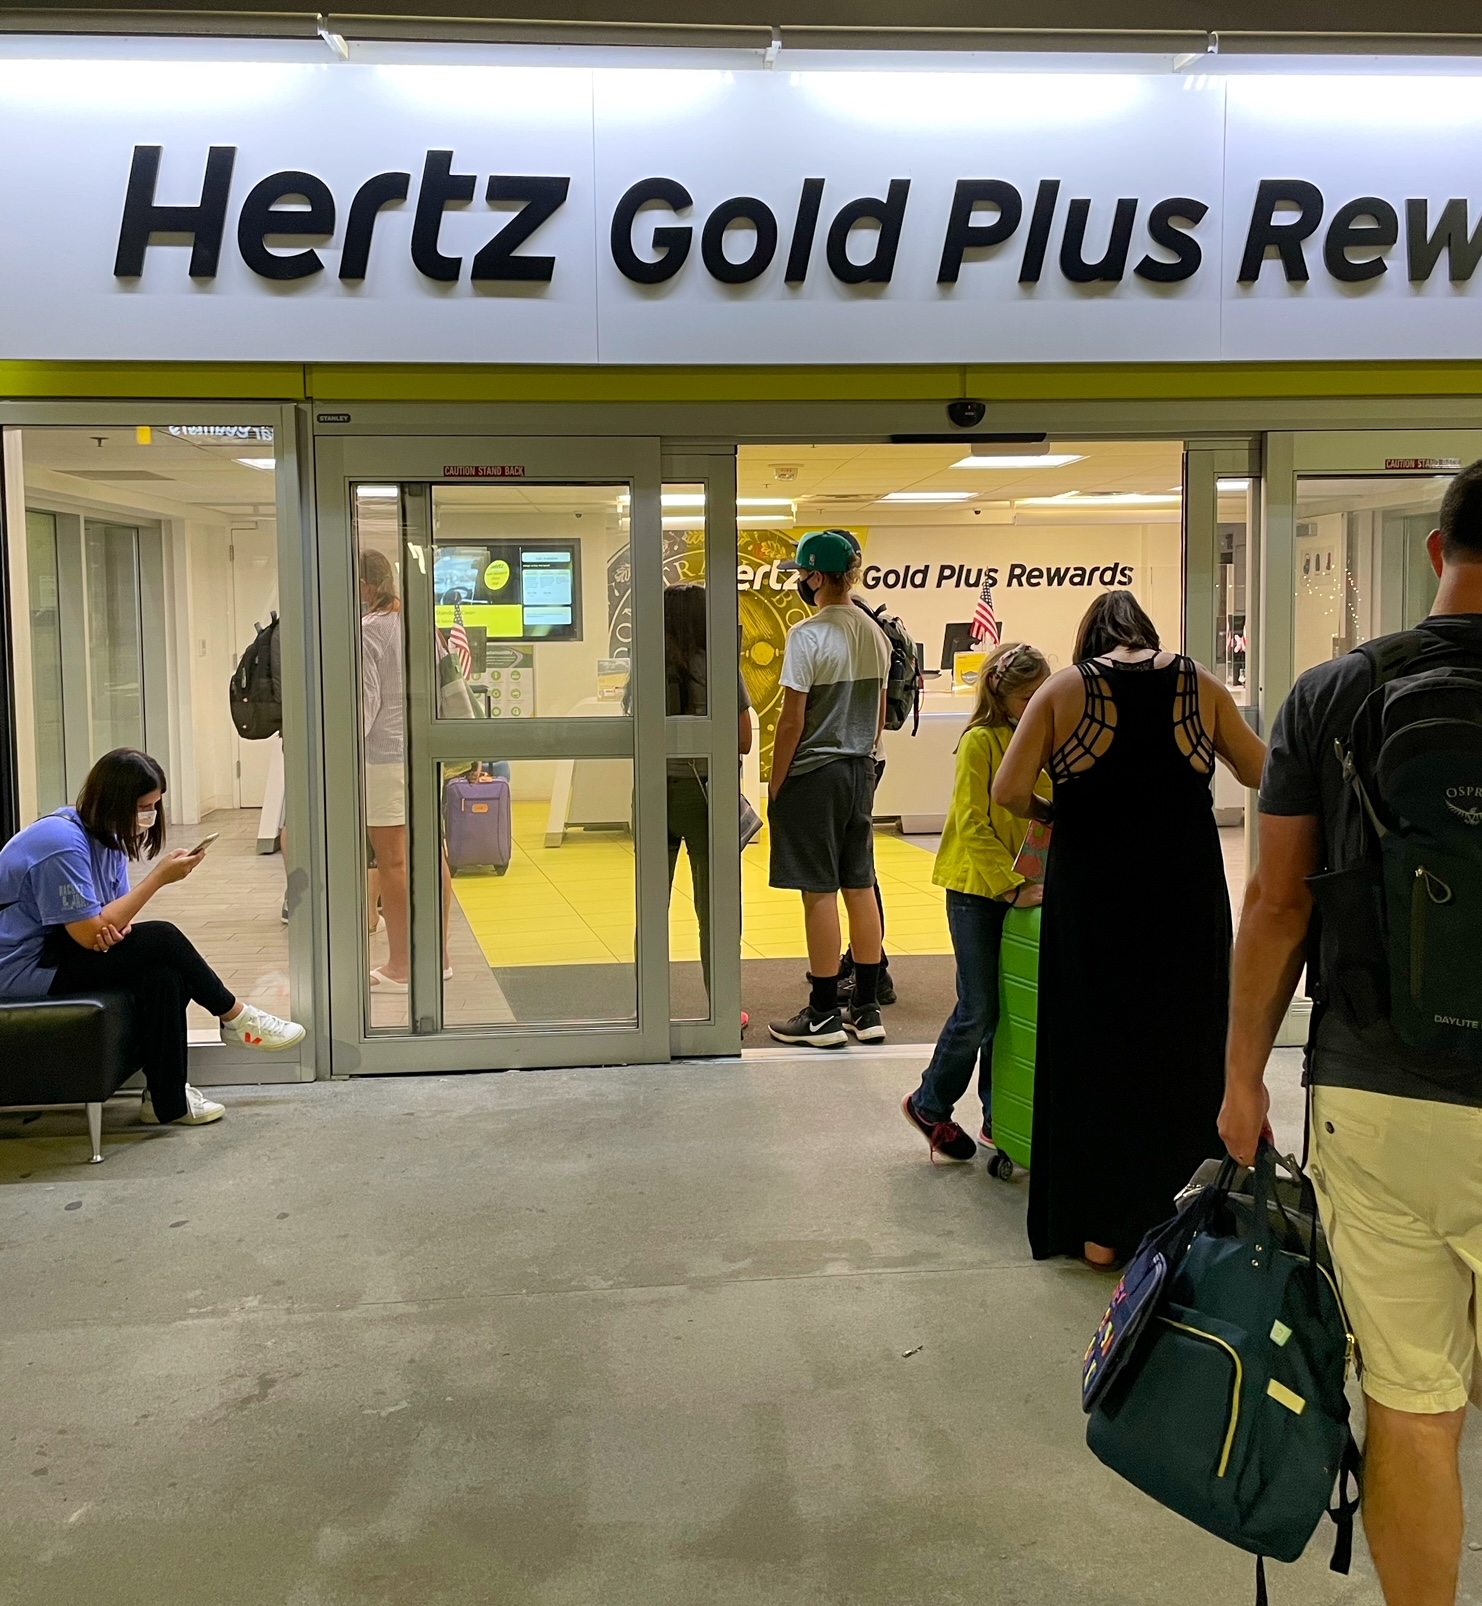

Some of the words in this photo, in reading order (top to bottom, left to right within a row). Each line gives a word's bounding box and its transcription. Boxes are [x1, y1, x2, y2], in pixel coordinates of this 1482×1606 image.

[114, 145, 571, 283] Hertz
[611, 177, 911, 285] Gold
[937, 178, 1209, 284] Plus
[444, 466, 475, 476] CAUTION
[478, 466, 502, 476] STAND
[504, 466, 524, 476] BACK
[1386, 459, 1415, 469] CAUTION
[737, 560, 800, 591] ertz
[862, 565, 930, 590] Gold
[935, 564, 999, 589] Plus
[1006, 562, 1134, 588] Rewards
[1434, 1014, 1479, 1029] DAYLITE
